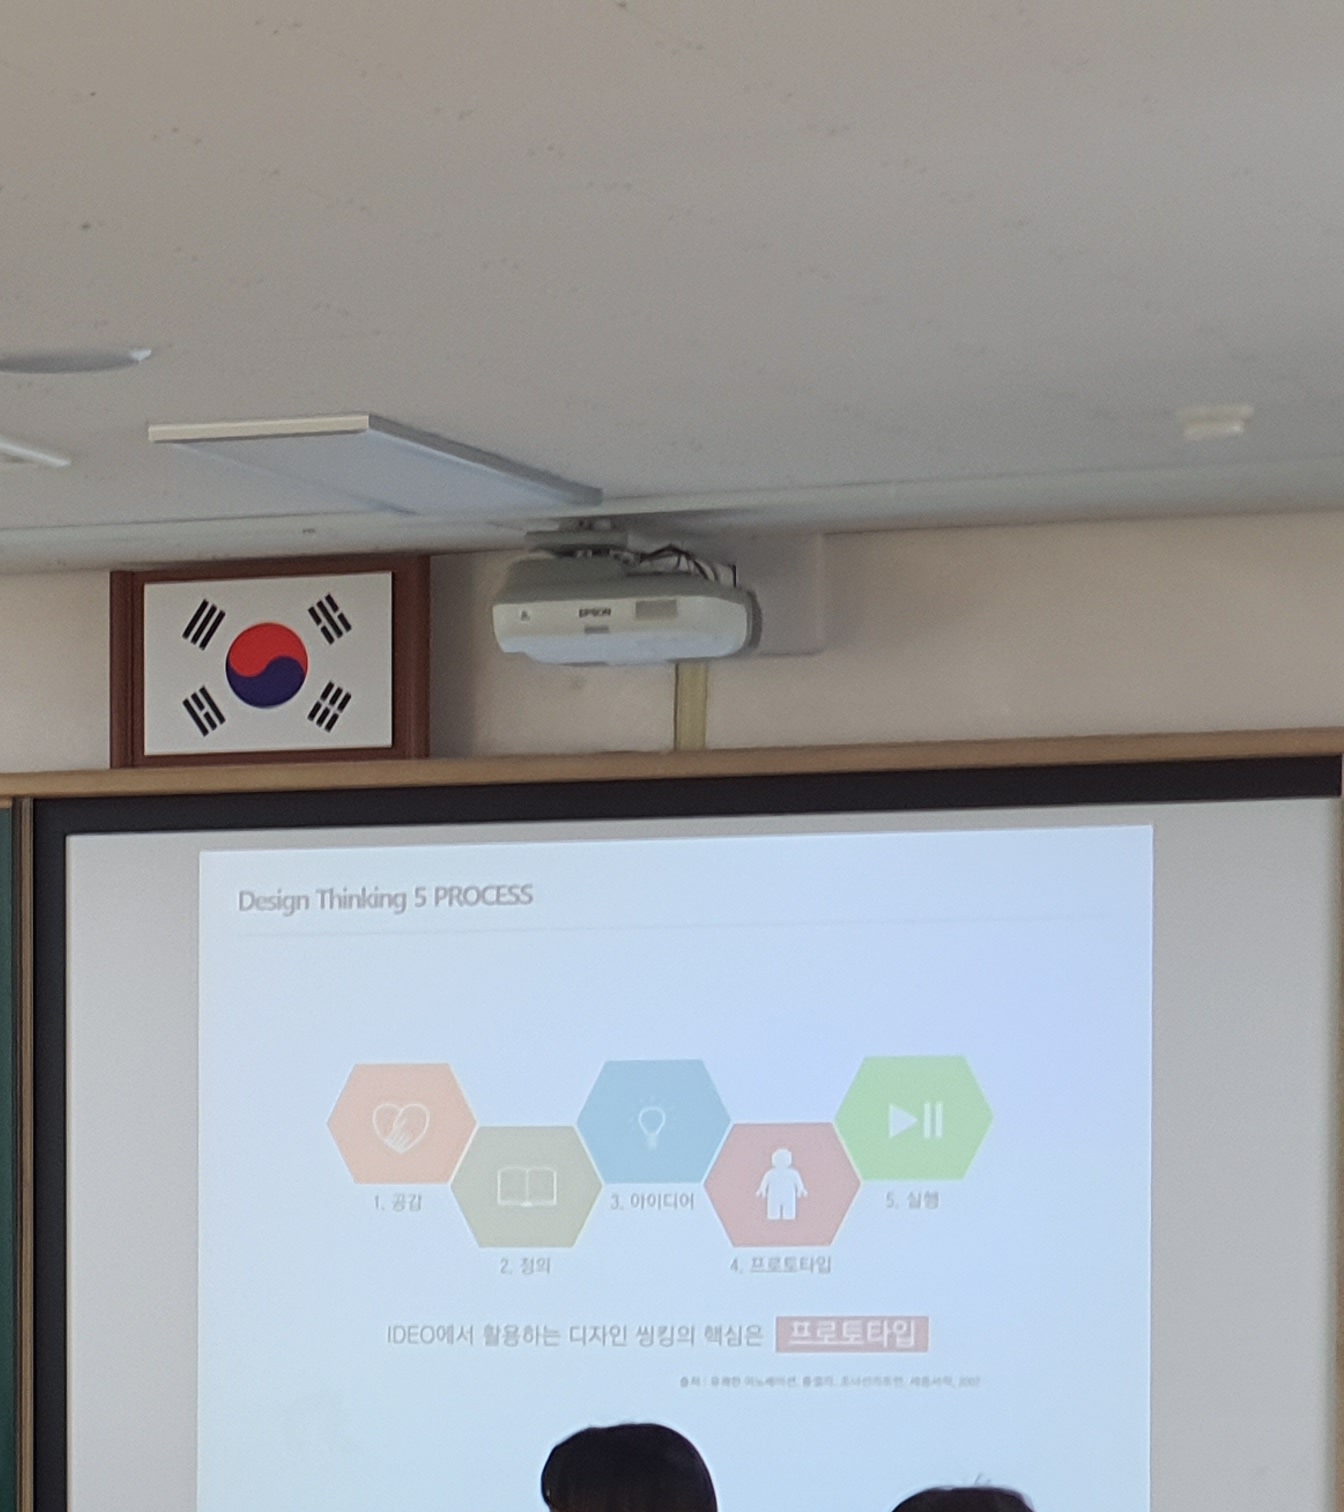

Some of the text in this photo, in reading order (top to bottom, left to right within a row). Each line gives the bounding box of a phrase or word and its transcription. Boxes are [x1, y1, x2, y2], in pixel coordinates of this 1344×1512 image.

[238, 884, 534, 917] Design Thinking 5 PROCESS
[392, 1192, 423, 1212] 공감
[630, 1191, 695, 1210] 아이디어
[907, 1190, 940, 1210] 실행
[520, 1256, 551, 1276] 정의
[749, 1255, 832, 1274] 프로토타입
[387, 1319, 915, 1348] IDEO에서 활용하는 디자인 씽킹의 핵심은 프로토타입
